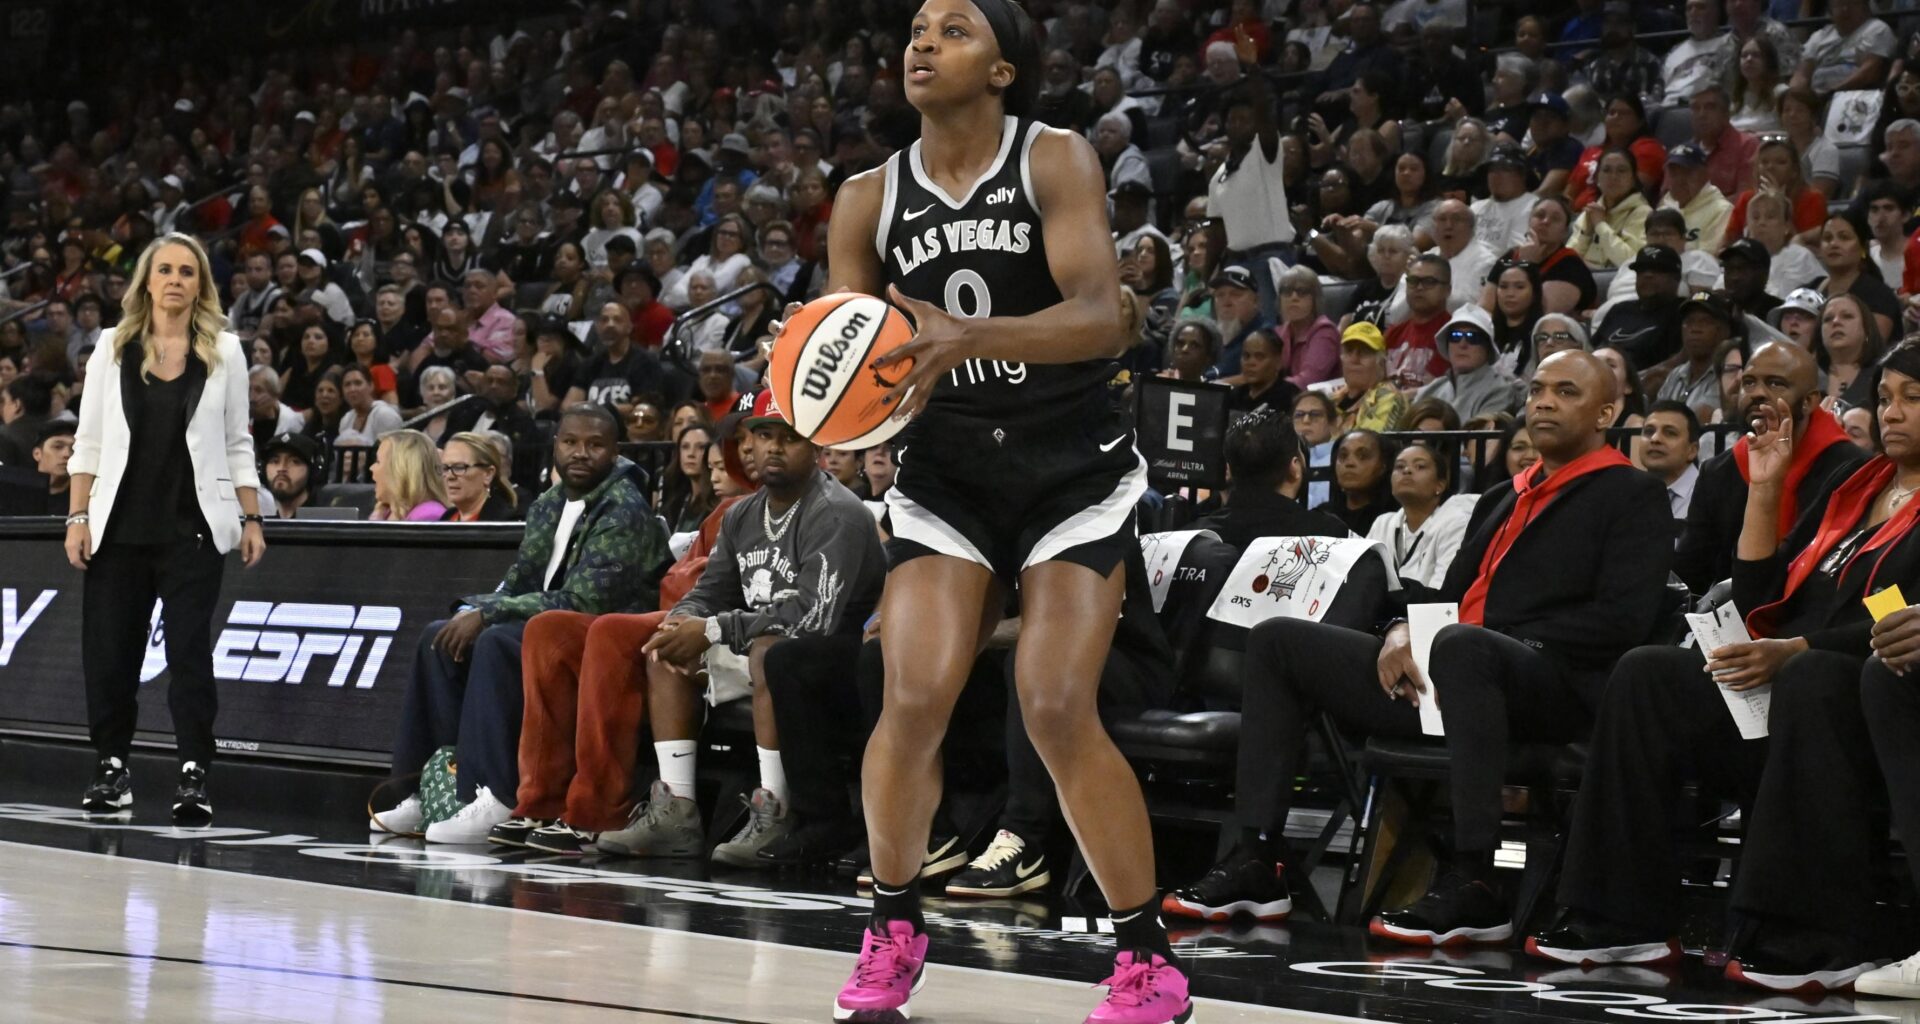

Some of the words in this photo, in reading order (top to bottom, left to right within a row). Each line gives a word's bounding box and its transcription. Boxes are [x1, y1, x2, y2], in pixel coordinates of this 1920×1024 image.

[986, 187, 1016, 205] ally
[893, 226, 941, 276] LAS
[942, 218, 1031, 254] VEGAS
[944, 269, 991, 319] 0
[801, 310, 872, 402] Wilson
[1166, 391, 1196, 452] E
[1167, 471, 1189, 480] ARENA
[1181, 461, 1205, 471] ULTRA
[1172, 567, 1207, 582] TRA
[213, 600, 402, 689] ESPN
